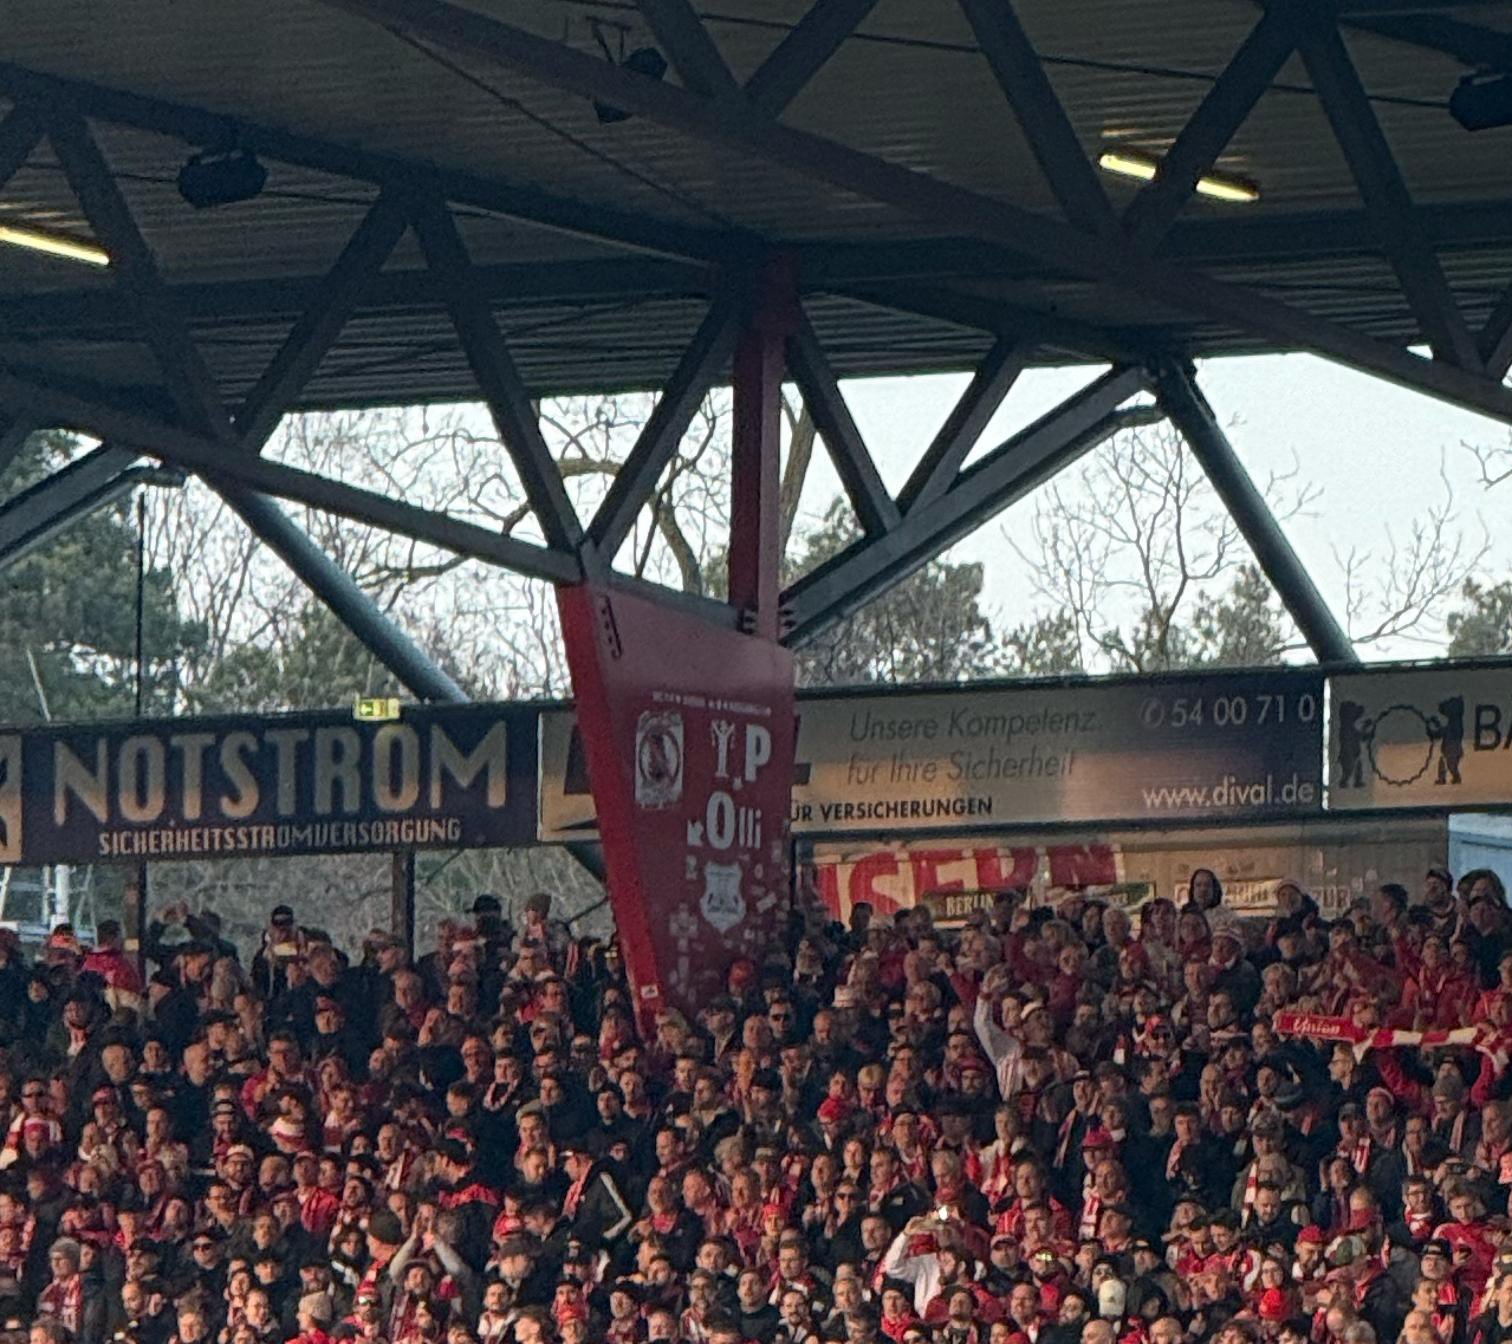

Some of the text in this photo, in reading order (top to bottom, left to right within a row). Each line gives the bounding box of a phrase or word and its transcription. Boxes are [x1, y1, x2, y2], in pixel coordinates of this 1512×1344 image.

[850, 707, 1098, 745] Unsere Kompetenz
[1213, 700, 1247, 726] 00
[54, 720, 507, 826] NOTSTROM
[846, 747, 1077, 785] für Ihre Sicherheit
[820, 797, 993, 822] VERSICHERUNGEN
[1140, 775, 1314, 809] www.dival.de
[99, 816, 462, 856] SICHERHEITSSTROMVERSORGUNG
